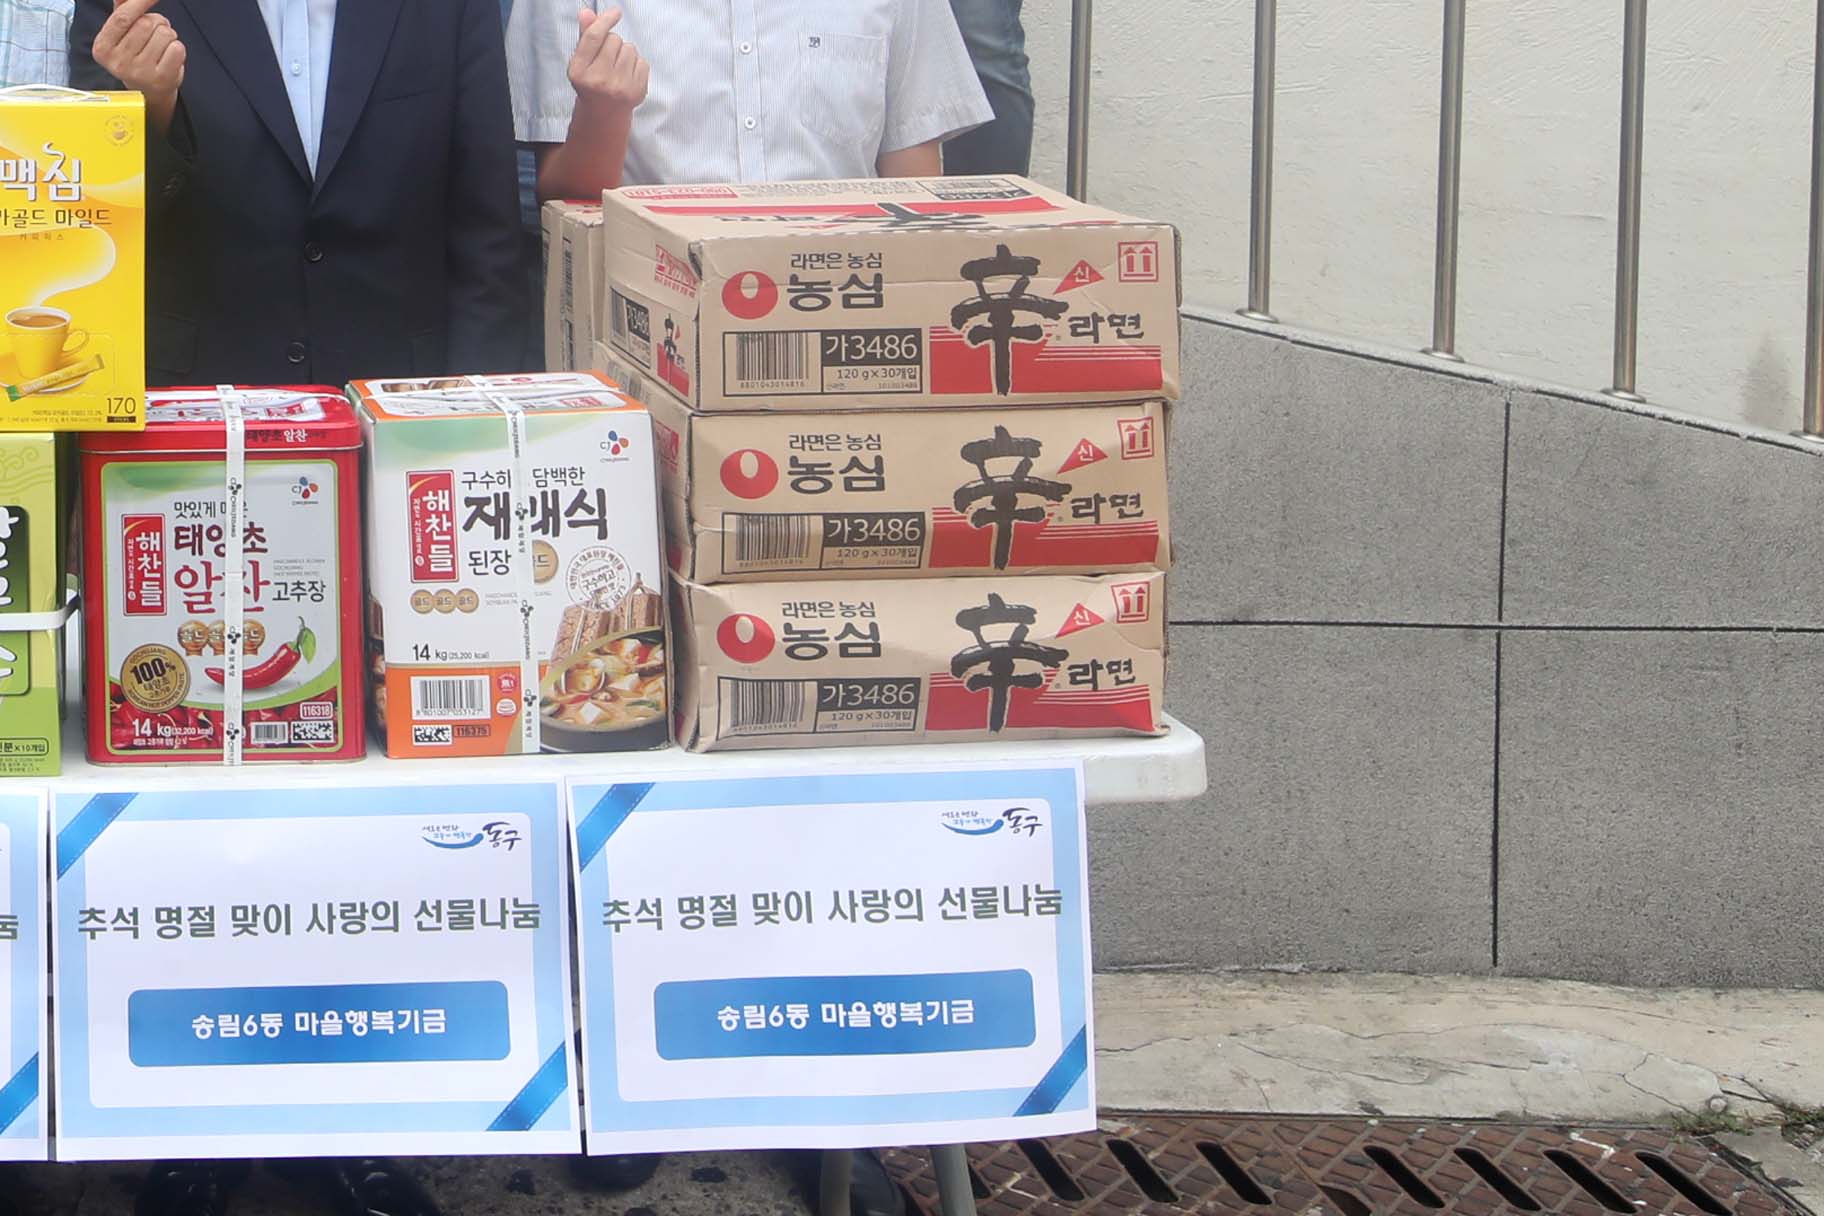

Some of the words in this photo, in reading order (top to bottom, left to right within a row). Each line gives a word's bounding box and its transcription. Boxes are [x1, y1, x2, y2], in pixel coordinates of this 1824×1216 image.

[55, 207, 112, 228] 마일드
[790, 252, 843, 270] 라면은
[847, 252, 882, 270] 농심
[1075, 267, 1091, 284] 신
[787, 272, 884, 311] 농심
[951, 244, 1069, 397] 辛
[1069, 311, 1145, 344] 라면
[826, 334, 917, 362] 가3486
[837, 368, 859, 379] 120
[107, 397, 136, 414] 170
[789, 434, 842, 451] 라면은
[845, 433, 882, 451] 농심
[1076, 444, 1095, 463] 신
[532, 467, 585, 487] 담백한
[787, 455, 886, 494] 농심
[174, 501, 216, 519] 맛있게
[953, 425, 1072, 570] 辛
[1071, 493, 1144, 524] 라면
[424, 490, 454, 572] 해찬들
[828, 518, 921, 544] 가3486
[467, 550, 511, 576] 된장
[837, 548, 860, 558] 120
[135, 532, 162, 607] 해찬들
[272, 582, 326, 603] 고추장
[782, 601, 835, 619] 라면은
[838, 600, 876, 618] 농심
[1074, 610, 1093, 627] 신
[412, 644, 430, 661] 14
[435, 650, 447, 662] kg
[781, 622, 882, 661] 농심
[950, 593, 1069, 733] 辛
[1067, 658, 1134, 692] 라면
[822, 683, 915, 707] 가3486
[133, 719, 152, 737] 14
[157, 721, 171, 738] kg
[831, 712, 854, 721] 120
[1003, 807, 1042, 838] 동구
[482, 821, 522, 852] 동구
[78, 906, 140, 940] 추석
[154, 904, 216, 939] 명절
[230, 902, 292, 936] 맞이
[305, 900, 400, 936] 사랑의
[414, 898, 541, 934] 선물나눔
[602, 898, 663, 933] 추석
[677, 895, 737, 930] 명절
[752, 890, 813, 927] 맞이
[827, 888, 923, 924] 사랑의
[937, 884, 1063, 921] 선물나눔
[192, 1011, 284, 1040] 송림6동
[294, 1008, 447, 1037] 마을행복기금
[717, 1003, 809, 1031] 송림6동
[821, 1000, 975, 1028] 마을행복기금
